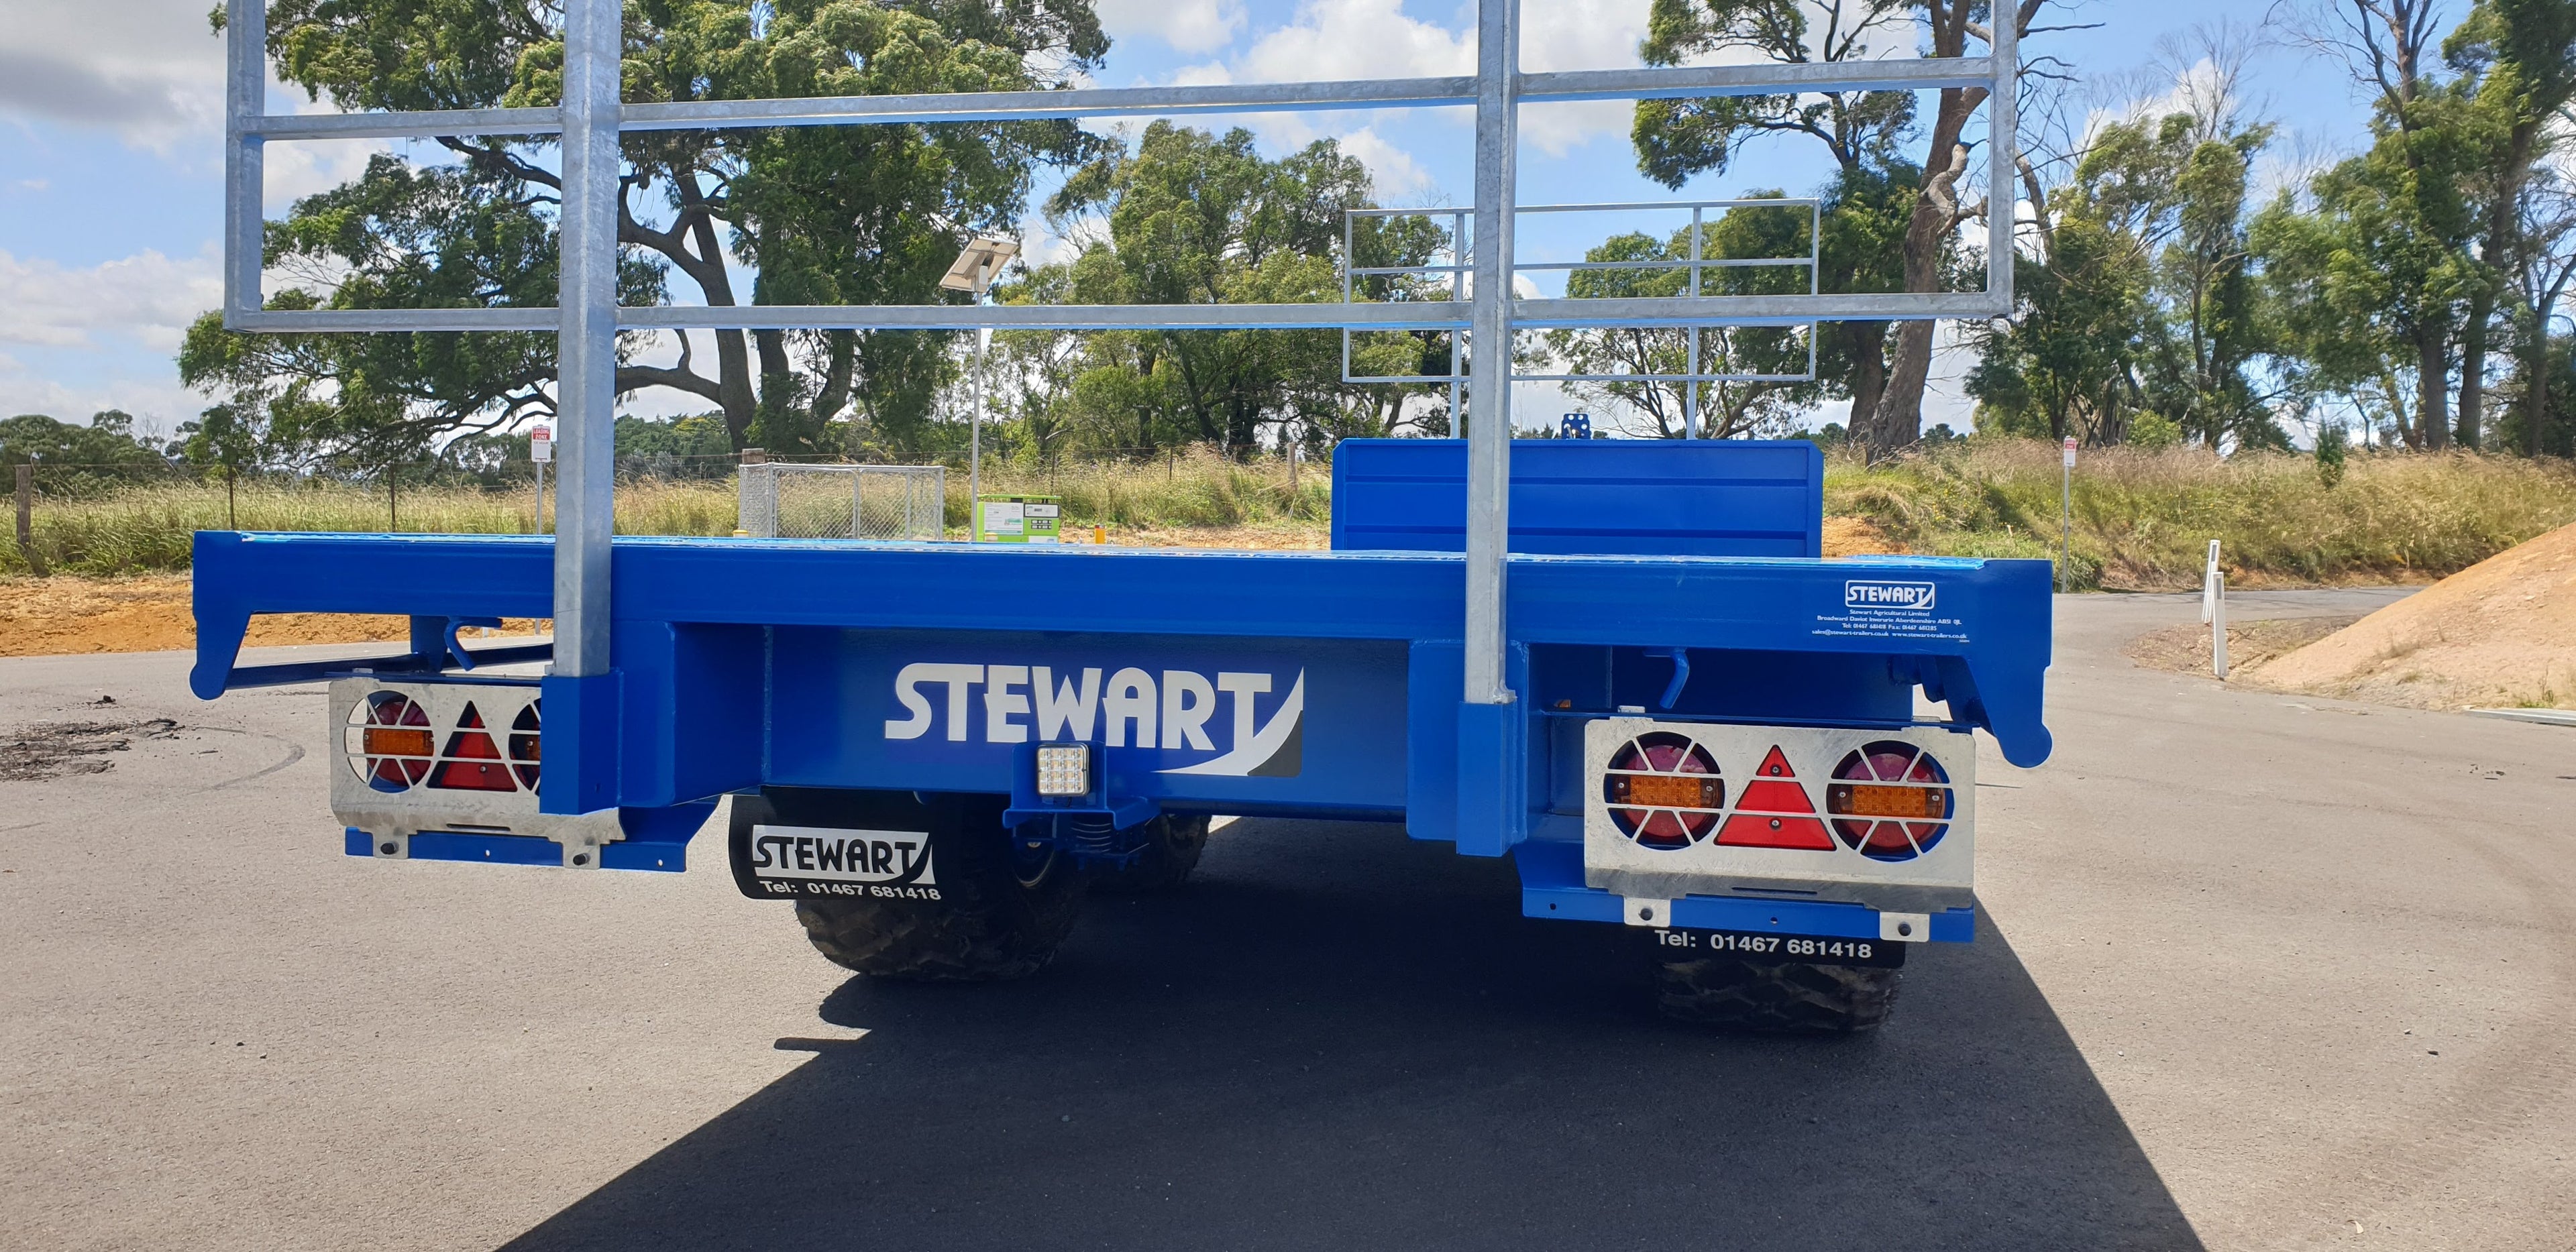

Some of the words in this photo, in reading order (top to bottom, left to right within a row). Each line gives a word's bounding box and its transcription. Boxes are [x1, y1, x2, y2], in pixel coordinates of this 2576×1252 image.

[1848, 585, 1932, 606] STEWART
[885, 663, 1303, 775] STEWART
[753, 836, 931, 882] STEWART
[759, 880, 798, 895] Tel:
[807, 883, 864, 897] 01467
[871, 886, 941, 900] 681418
[1654, 929, 1696, 948] Tel:
[1710, 933, 1780, 952] 01467
[1787, 940, 1872, 959] 681418
